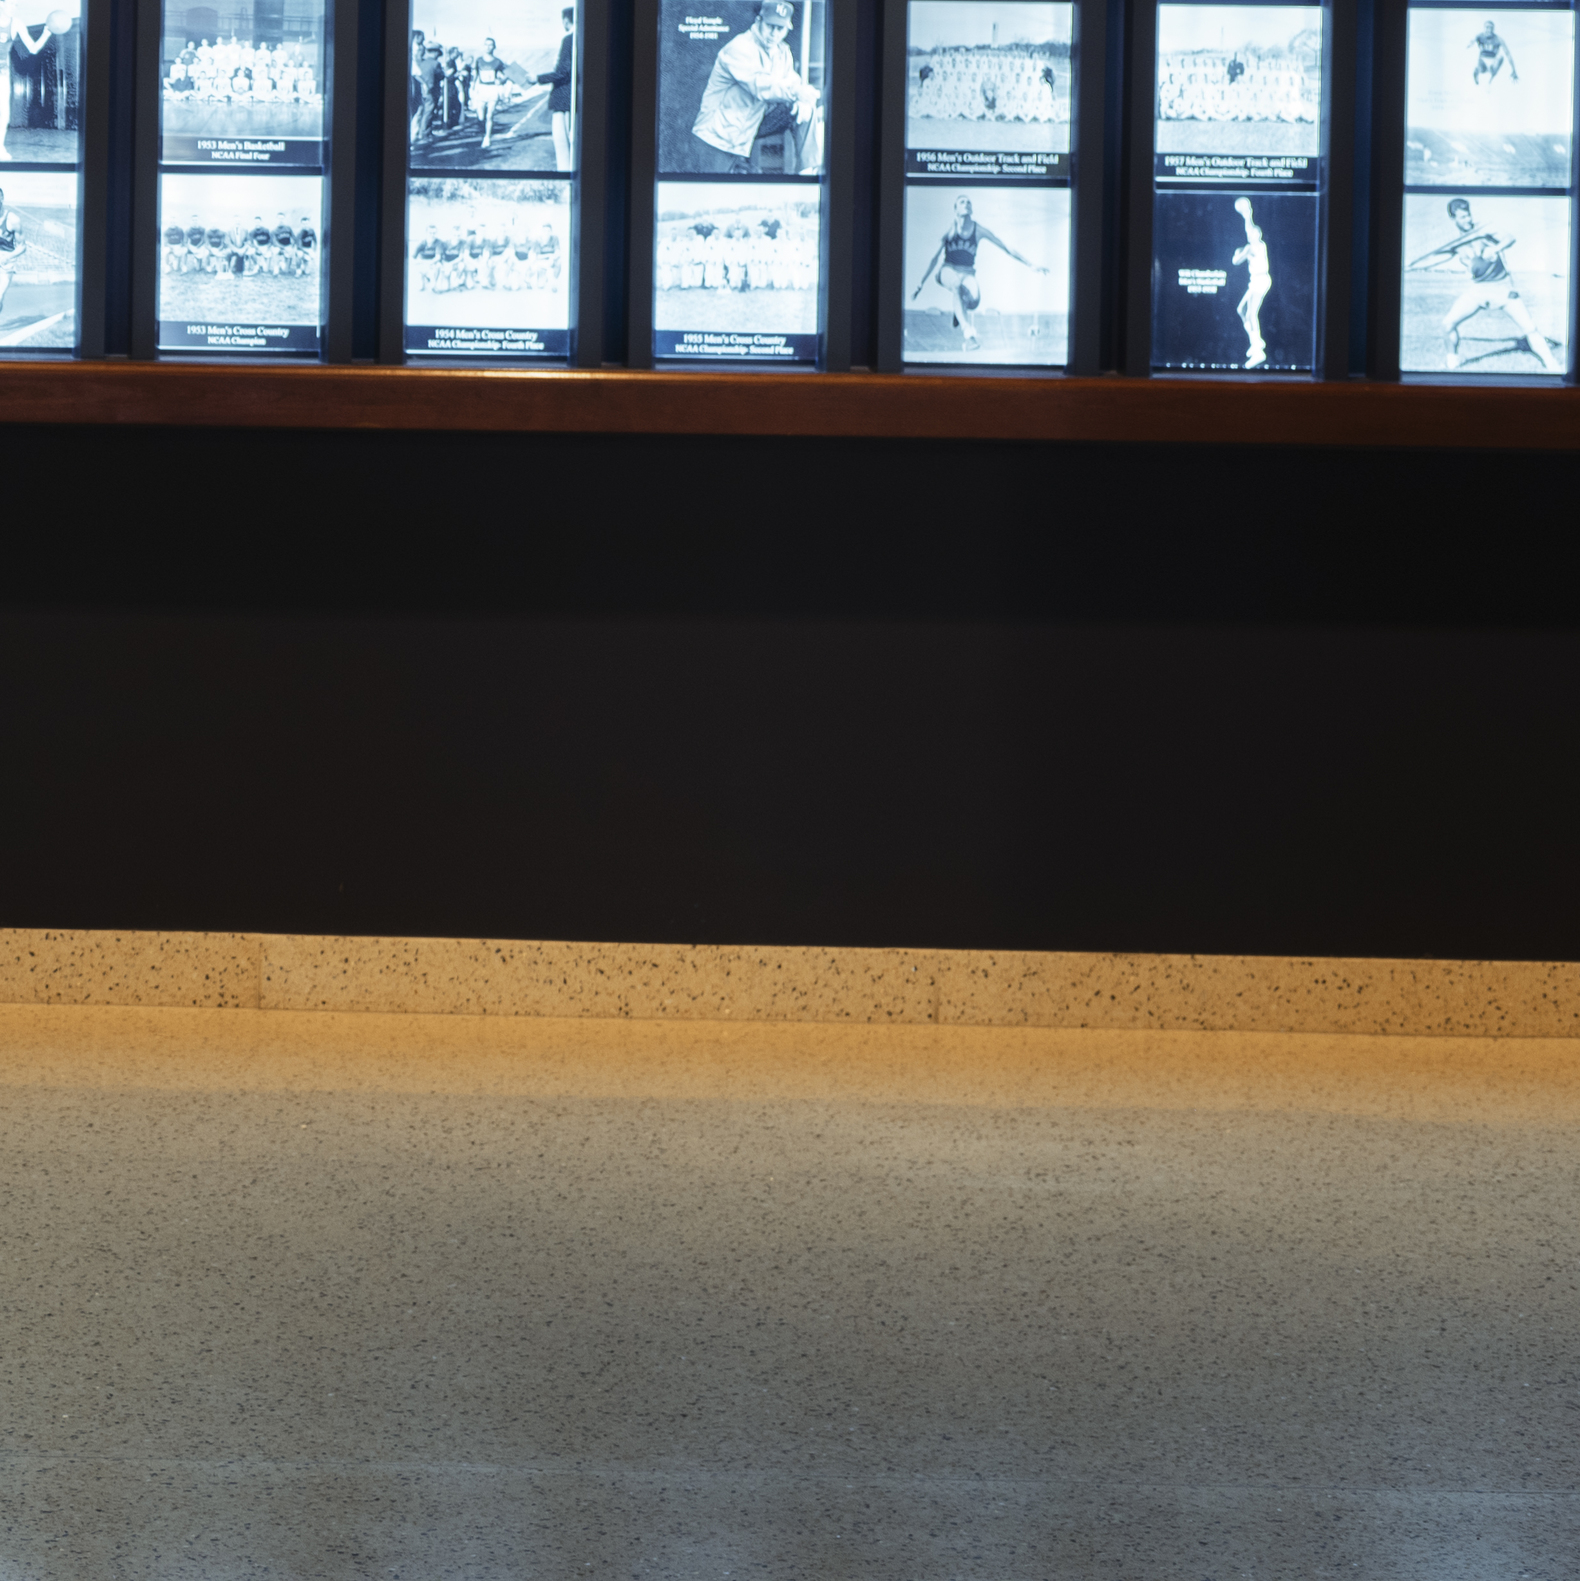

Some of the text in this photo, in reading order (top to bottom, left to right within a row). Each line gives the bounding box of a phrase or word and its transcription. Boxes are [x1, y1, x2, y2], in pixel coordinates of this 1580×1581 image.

[197, 140, 285, 151] 1953 Men's Basketball
[187, 325, 289, 337] 1953 Men's Cross Country
